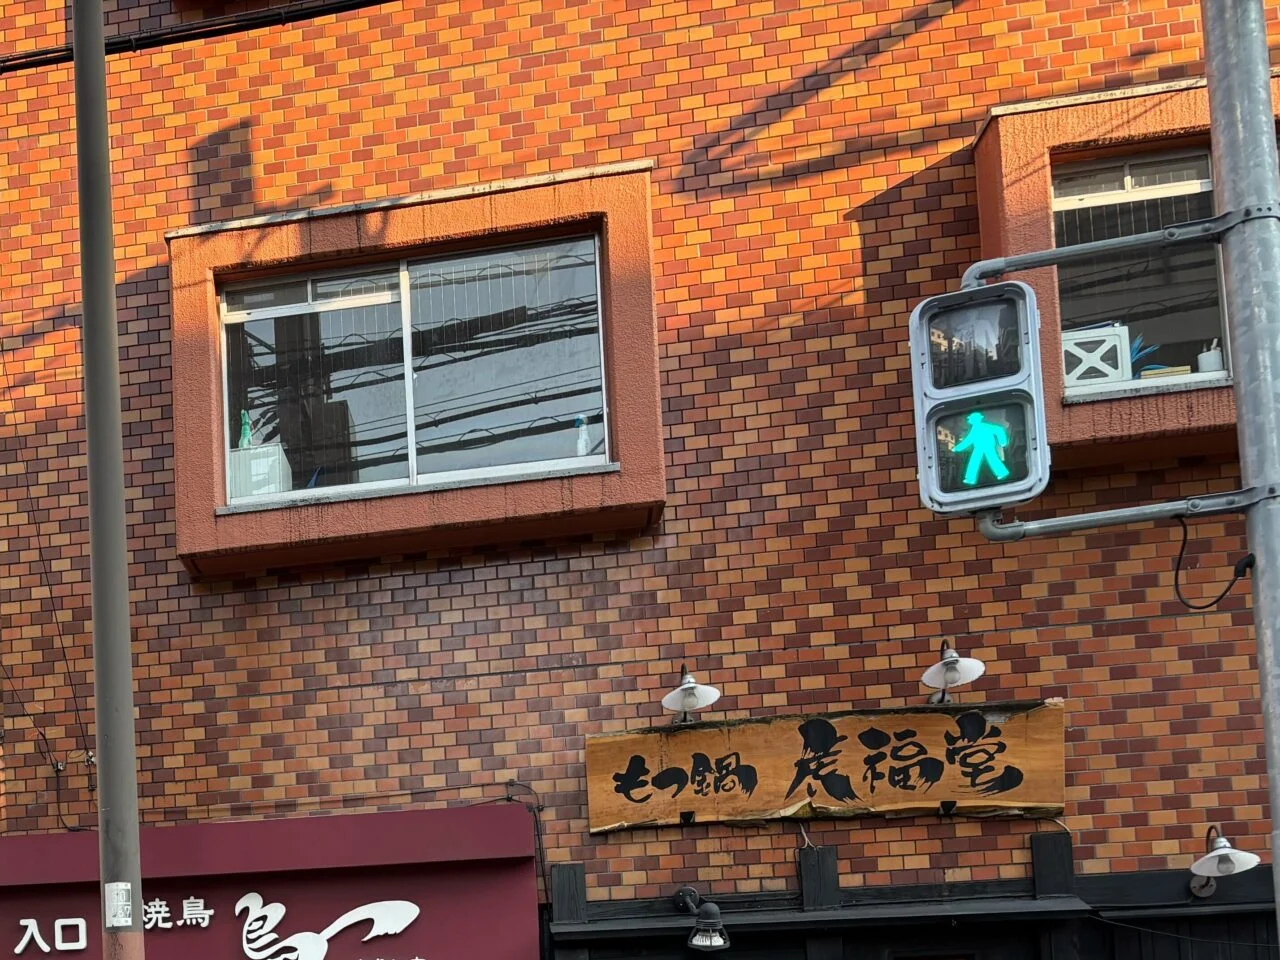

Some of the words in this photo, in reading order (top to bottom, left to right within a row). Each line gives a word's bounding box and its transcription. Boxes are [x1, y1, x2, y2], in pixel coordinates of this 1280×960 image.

[612, 752, 758, 803] もつ鍋
[142, 896, 214, 929] 焼鳥
[14, 917, 87, 954] 入口
